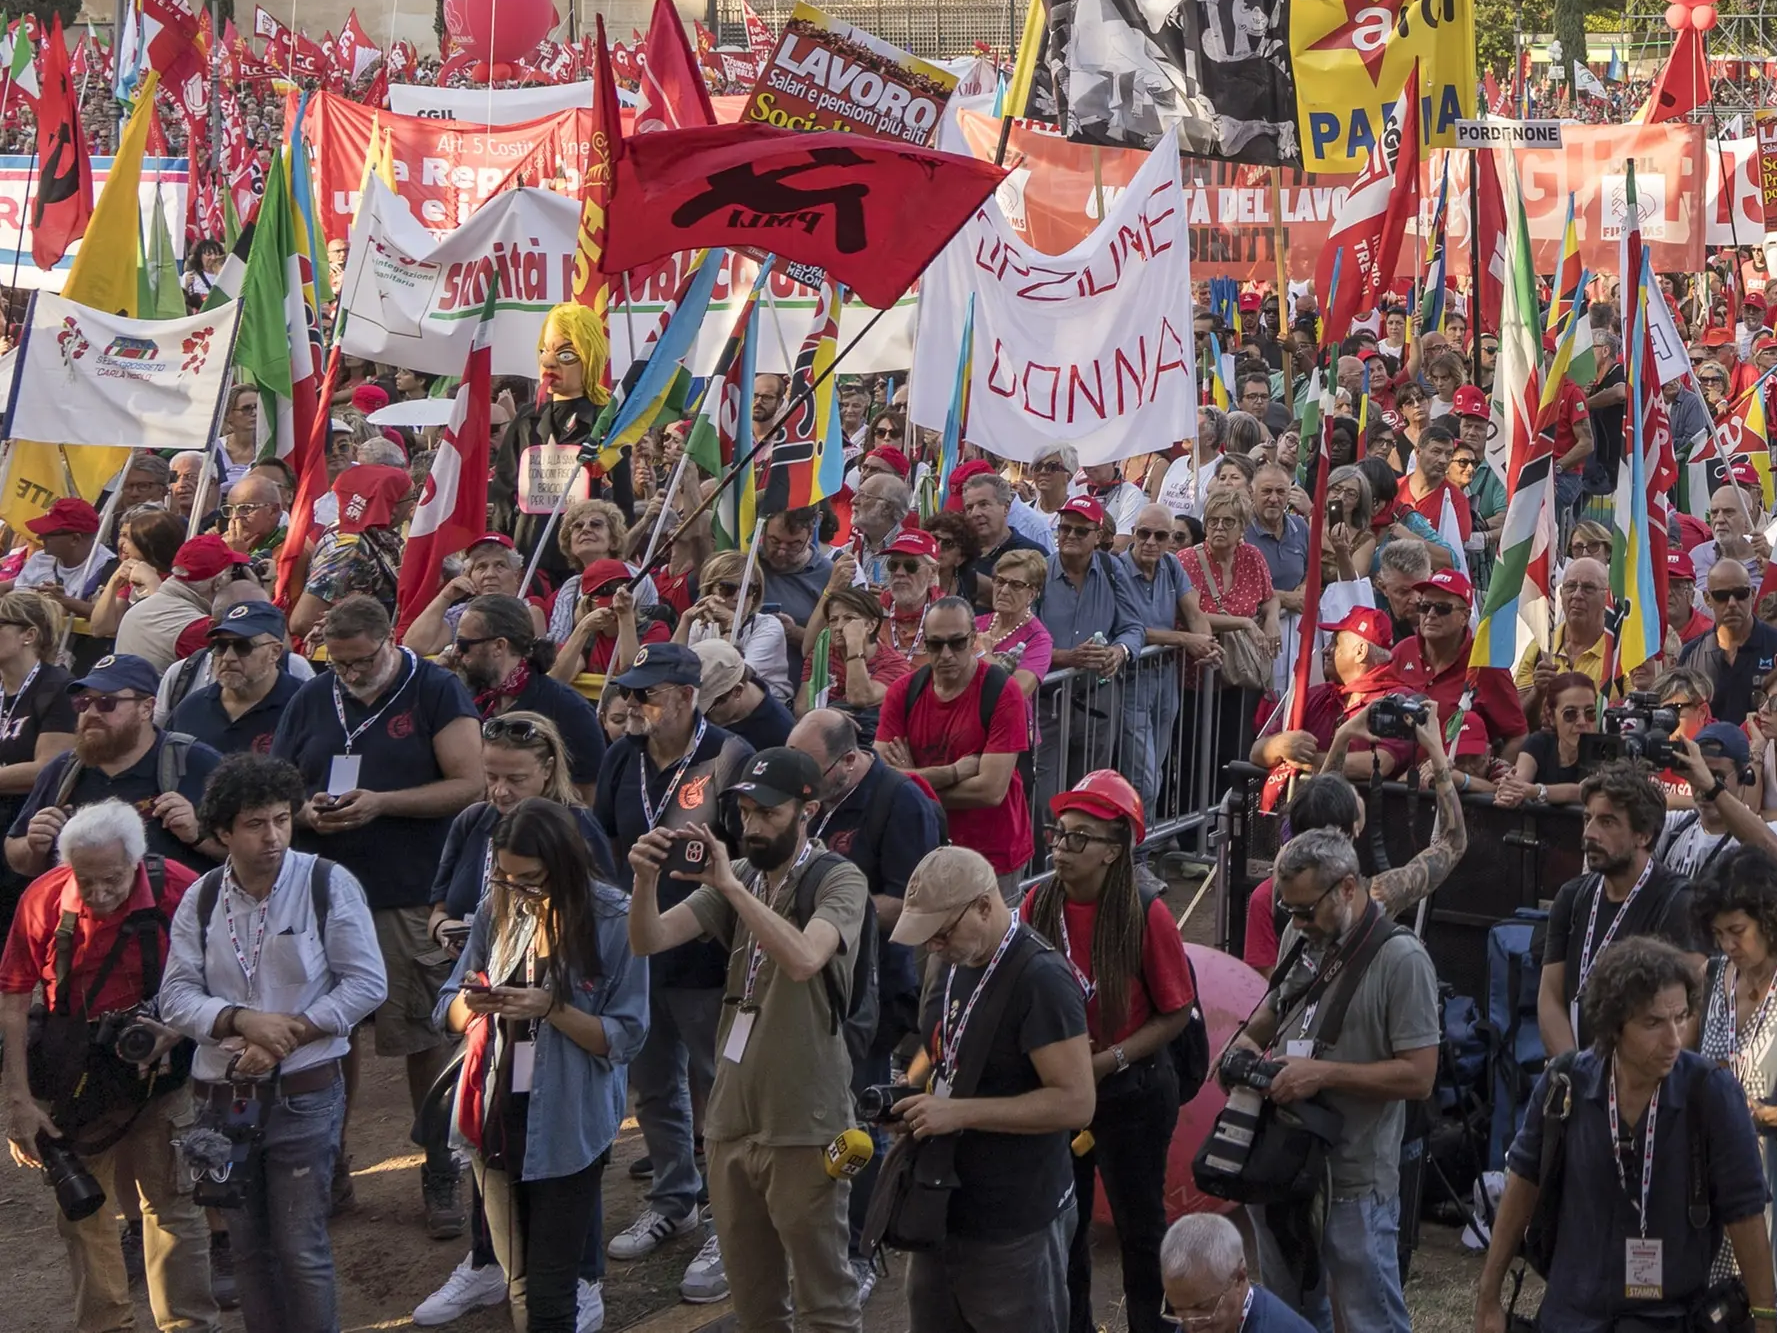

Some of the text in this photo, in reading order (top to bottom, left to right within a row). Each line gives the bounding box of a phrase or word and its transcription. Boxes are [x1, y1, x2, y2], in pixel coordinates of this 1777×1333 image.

[773, 32, 941, 130] LAVORO
[416, 109, 457, 121] CGIL
[766, 67, 930, 147] Salari e pensioni più alti
[436, 135, 468, 153] Art.
[472, 136, 485, 154] 5
[1458, 125, 1559, 142] PORDENONE
[1217, 185, 1351, 224] DEL LAVO
[374, 258, 435, 282] integrazione
[438, 236, 548, 309] sanità
[1323, 959, 1344, 983] EOS
[1627, 1286, 1661, 1298] STAMPA
